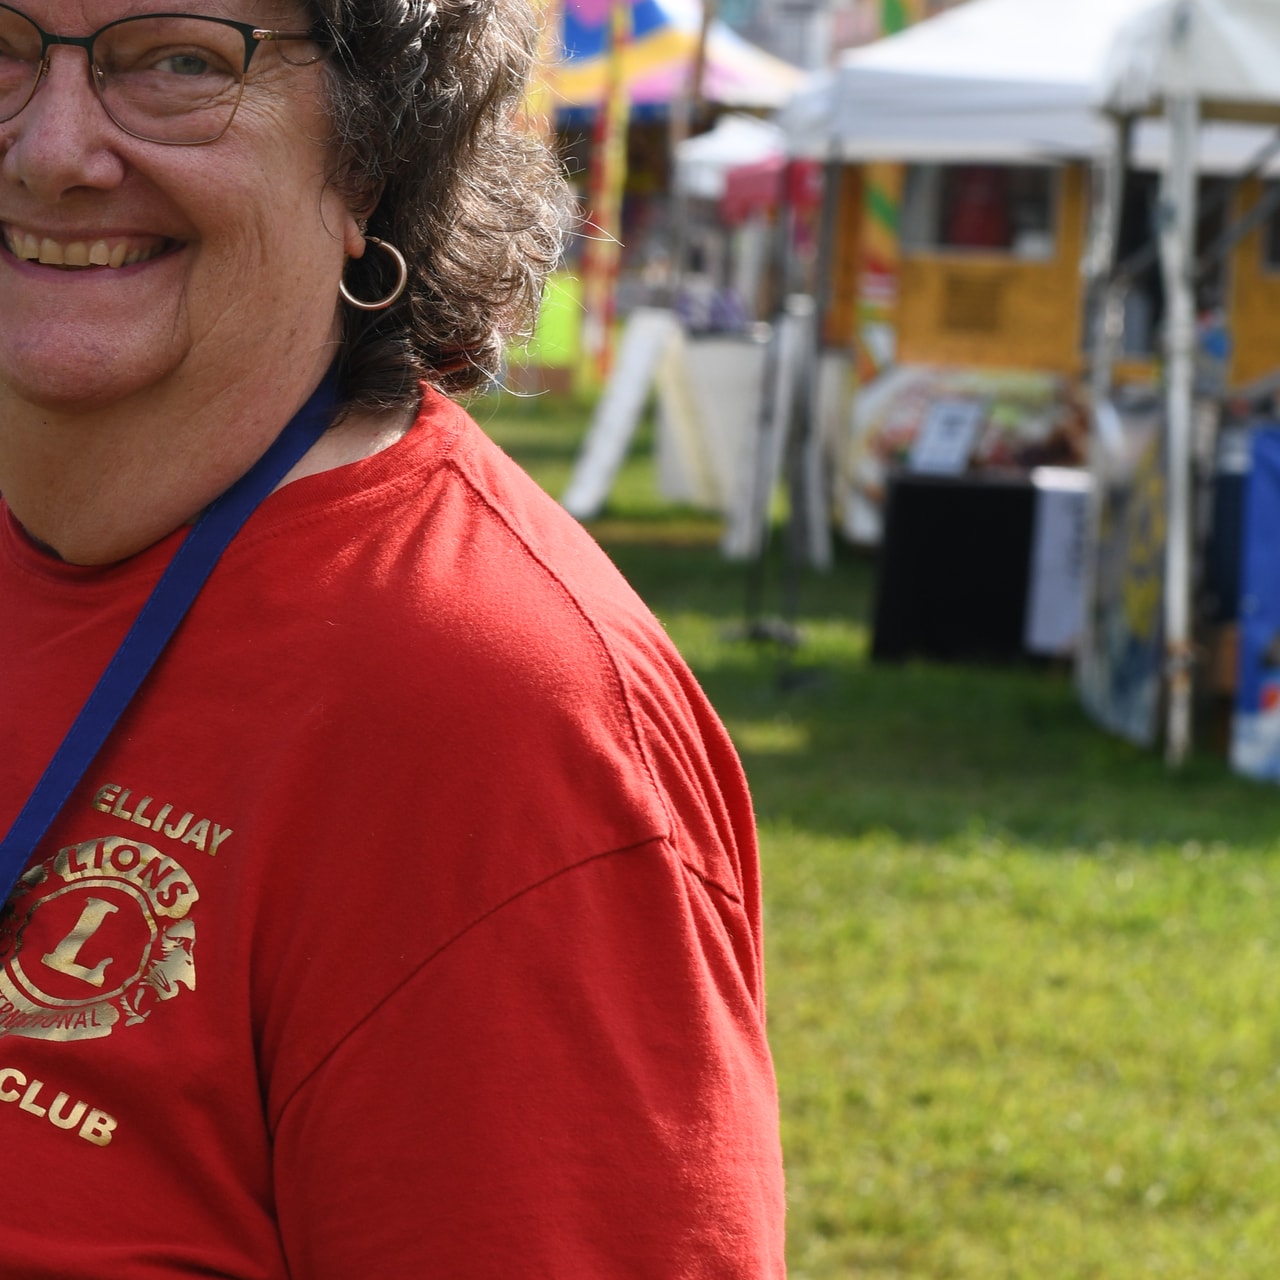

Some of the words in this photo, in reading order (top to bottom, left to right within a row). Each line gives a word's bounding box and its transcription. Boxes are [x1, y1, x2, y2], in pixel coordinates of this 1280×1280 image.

[92, 783, 233, 857] ELLIJAY
[67, 844, 190, 908] LIONS
[41, 896, 119, 988] L
